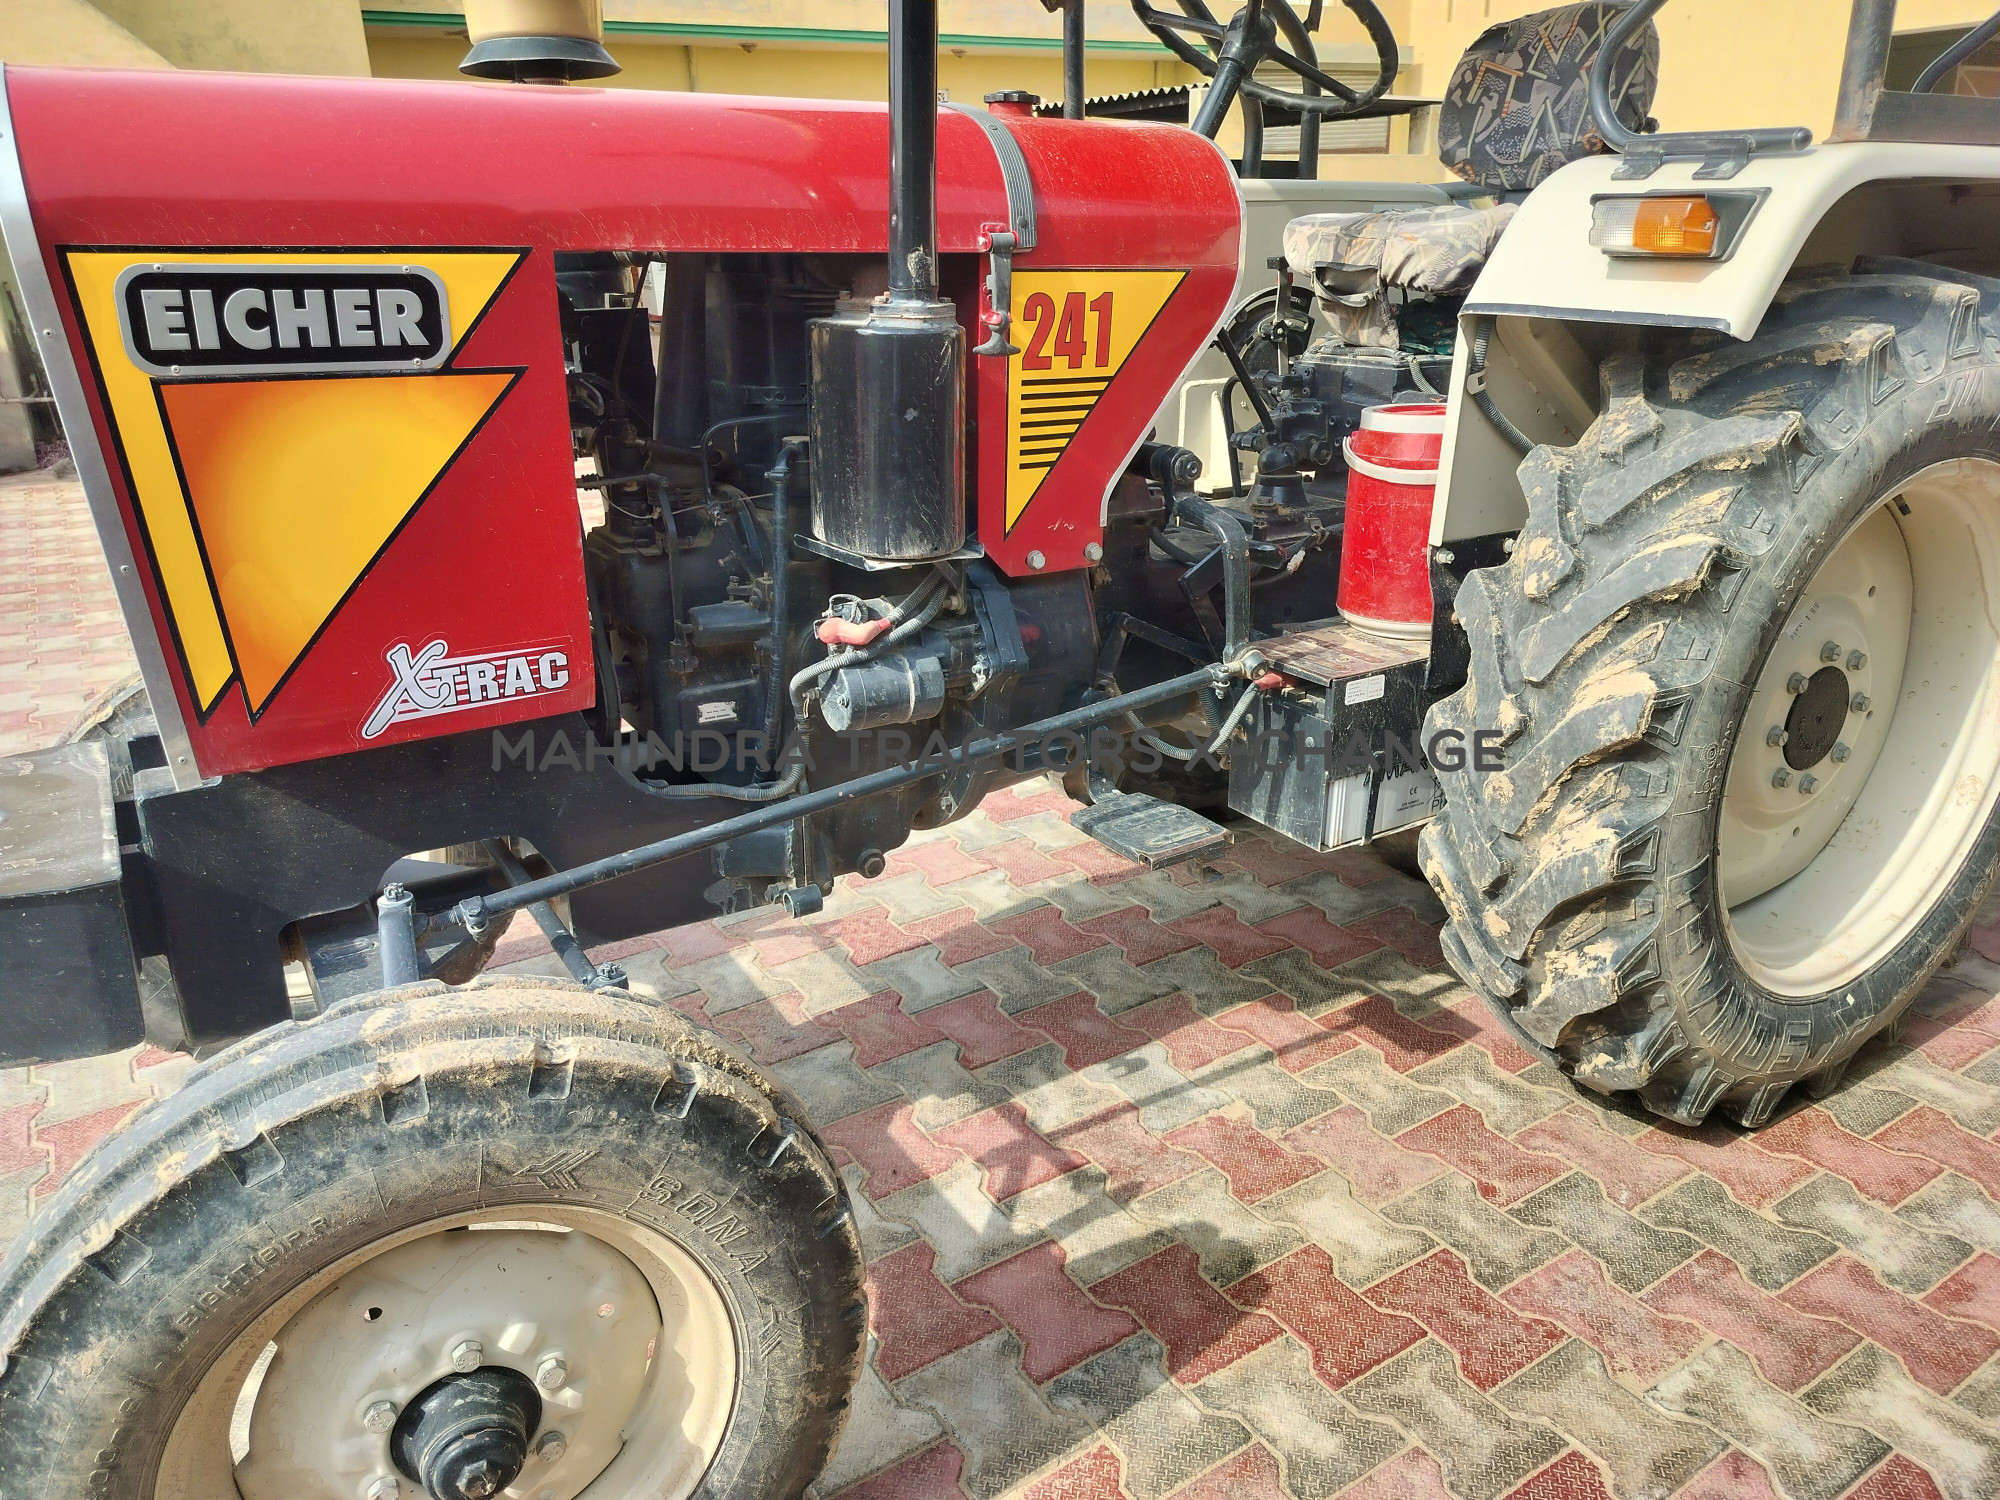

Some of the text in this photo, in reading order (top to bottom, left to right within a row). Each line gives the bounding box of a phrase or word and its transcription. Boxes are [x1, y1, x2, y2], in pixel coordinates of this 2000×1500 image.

[140, 288, 430, 351] EICHER
[1021, 291, 1114, 371] 241
[638, 1174, 769, 1275] SONA
